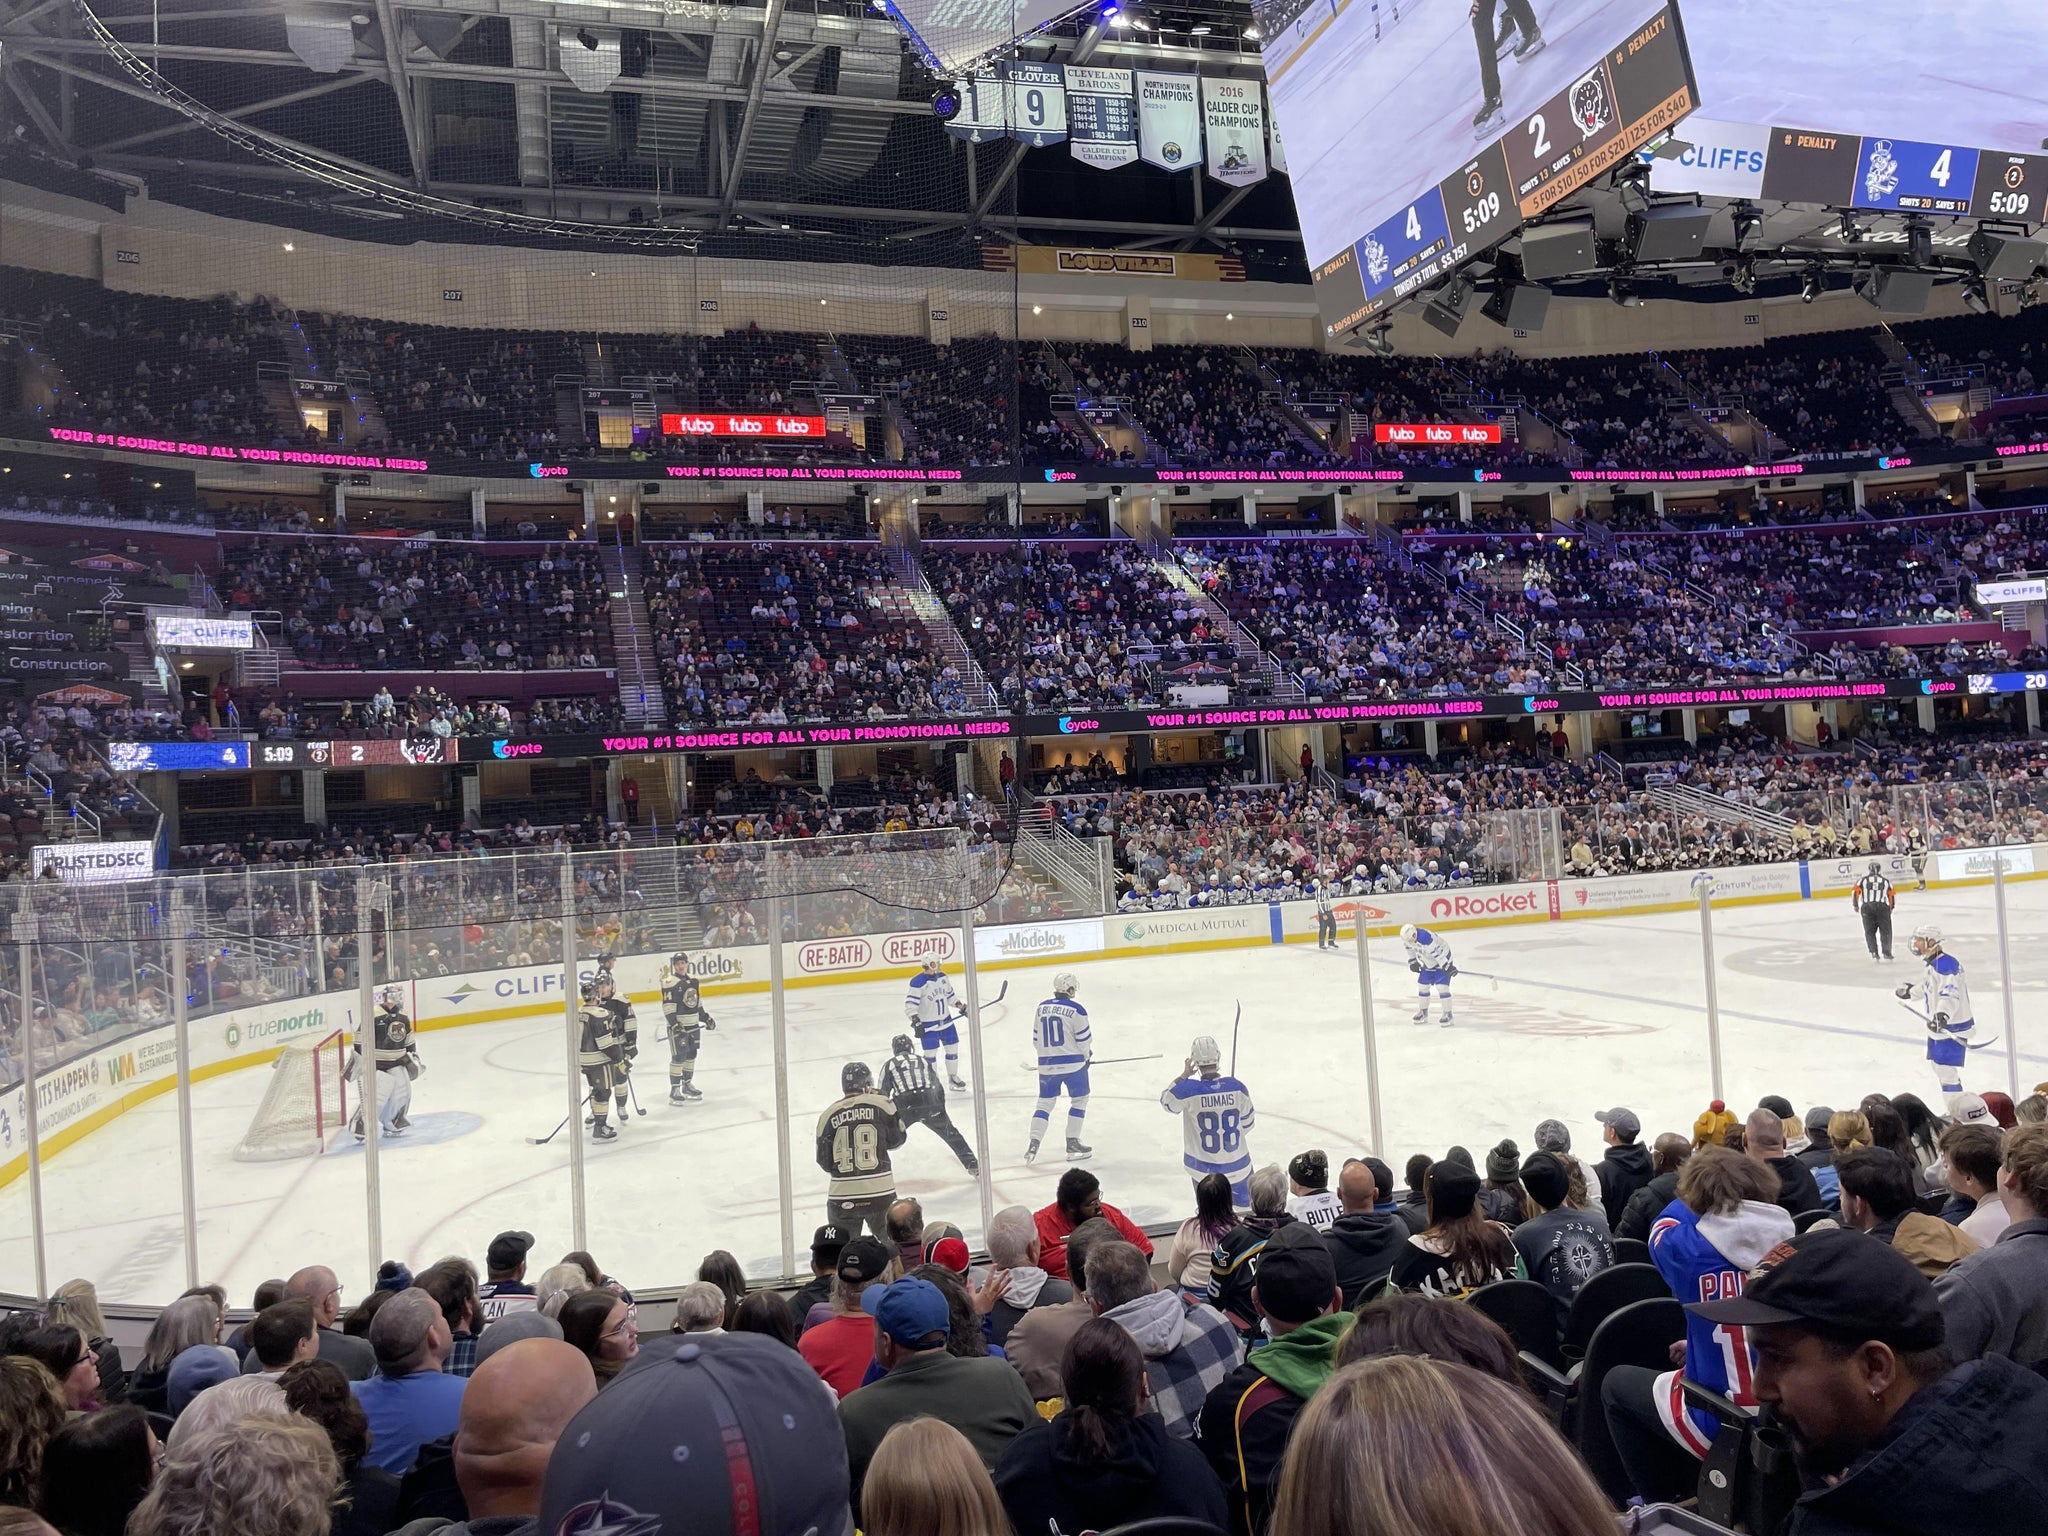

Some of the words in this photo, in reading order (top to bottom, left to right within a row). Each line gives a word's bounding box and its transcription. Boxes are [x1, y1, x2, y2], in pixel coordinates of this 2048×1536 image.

[1628, 16, 1666, 56] PENALTY
[1009, 71, 1059, 83] GLOVER
[1067, 69, 1129, 81] CLEVELAND
[1078, 80, 1121, 90] BARONS
[1164, 82, 1190, 90] DIVISION
[1220, 86, 1244, 98] 2016
[1143, 88, 1194, 102] CHAMPIONS
[1026, 89, 1045, 126] 9
[1206, 101, 1238, 114] CALDER
[1242, 103, 1259, 115] CUP
[1208, 115, 1260, 128] CHAMPIONS
[1528, 114, 1551, 159] 2
[1798, 136, 1837, 150] PENALTY
[1533, 196, 1540, 210] 5
[1540, 186, 1557, 205] FOR
[1557, 175, 1572, 196] $10
[1578, 166, 1589, 180] 50
[1590, 155, 1607, 176] FOR
[1609, 138, 1625, 165] $20
[1630, 126, 1646, 146] 125
[1648, 112, 1665, 132] FOR
[1666, 95, 1686, 120] $40
[1680, 146, 1764, 174] CLIFFS
[1520, 177, 1538, 194] SHOTS
[1540, 169, 1549, 182] 13
[1552, 154, 1571, 172] SAVES
[1572, 148, 1582, 160] 16
[1930, 149, 1951, 187] 4
[2010, 171, 2018, 182] 2
[1472, 179, 1478, 189] 2
[1900, 196, 1920, 208] SHOTS
[1920, 198, 1932, 209] 20
[1934, 198, 1955, 210] SAVES
[1956, 200, 1966, 212] 11
[1989, 191, 2030, 214] 5:09
[1462, 192, 1500, 234] 5:09
[1406, 206, 1422, 241] 4
[118, 252, 139, 262] 206
[1058, 252, 1175, 275] LOUDVILLE
[1323, 252, 1350, 276] PENALTY
[1394, 262, 1410, 278] SHOTS
[1409, 256, 1418, 268] 20
[1420, 246, 1436, 261] SAVES
[1436, 238, 1445, 249] 11
[1392, 271, 1422, 298] TONIGHT'S
[1422, 262, 1440, 282] TOTAL
[1440, 242, 1468, 269] $5,757
[444, 290, 462, 300] 207
[701, 301, 718, 311] 208
[932, 310, 948, 320] 209
[1132, 318, 1147, 328] 210
[1334, 316, 1352, 332] 50/50
[1352, 303, 1374, 323] RAFFLE
[680, 417, 715, 434] fubo
[729, 418, 762, 433] fubo
[776, 418, 809, 434] fubo
[1389, 427, 1416, 440] fubo
[1426, 427, 1452, 440] fubo
[1462, 428, 1488, 441] fubo
[50, 428, 94, 442] YOUR
[96, 434, 114, 446] #1
[116, 436, 176, 452] SOURCE
[178, 442, 208, 456] FOR
[210, 444, 238, 458] ALL
[240, 448, 280, 460] YOUR
[282, 452, 384, 468] PROMOTIONAL
[386, 458, 428, 470] NEEDS
[1996, 444, 2026, 456] YOUR
[2003, 586, 2043, 596] CLIFFS
[194, 627, 249, 639] CLIFFS
[2025, 674, 2046, 688] 20
[1598, 694, 1632, 706] YOUR
[1634, 694, 1646, 704] #1
[1648, 692, 1694, 704] SOURCE
[1694, 690, 1718, 702] FOR
[1720, 690, 1740, 702] ALL
[1742, 688, 1772, 700] YOUR
[1774, 686, 1852, 700] PROMOTIONAL
[1852, 684, 1886, 696] NEEDS
[1146, 714, 1184, 726] YOUR
[1186, 714, 1202, 724] #1
[1204, 710, 1256, 724] SOURCE
[1260, 710, 1286, 722] FOR
[1288, 708, 1312, 720] ALL
[1314, 706, 1350, 720] YOUR
[1352, 702, 1442, 718] PROMOTIONAL
[1444, 700, 1484, 714] NEEDS
[602, 736, 648, 750] YOUR
[654, 736, 672, 748] #1
[674, 732, 738, 748] SOURCE
[742, 732, 774, 744] FOR
[776, 730, 806, 742] ALL
[808, 728, 852, 742] YOUR
[854, 724, 962, 740] PROMOTIONAL
[964, 722, 1010, 734] NEEDS
[264, 747, 294, 762] 5:09
[351, 746, 364, 760] 2
[1716, 882, 1752, 891] CENTURY
[1455, 890, 1538, 916] Rocket
[1148, 922, 1198, 934] MEDICAL
[1201, 919, 1248, 930] MUTUAL
[1008, 932, 1058, 950] Modelo
[936, 999, 946, 1016] 11
[1052, 1006, 1075, 1018] BELLUZ
[248, 1008, 324, 1040] truenorth
[1040, 1016, 1064, 1048] 10
[108, 1052, 136, 1086] WM
[54, 1064, 90, 1100] HAPPEN
[1201, 1094, 1235, 1108] DUMAIS
[830, 1108, 874, 1130] GUCCIARDI
[1197, 1108, 1241, 1154] 88
[832, 1123, 879, 1174] 48
[1306, 1205, 1344, 1226] BUTLE
[824, 1226, 836, 1240] NY
[1714, 1474, 1721, 1484] 6
